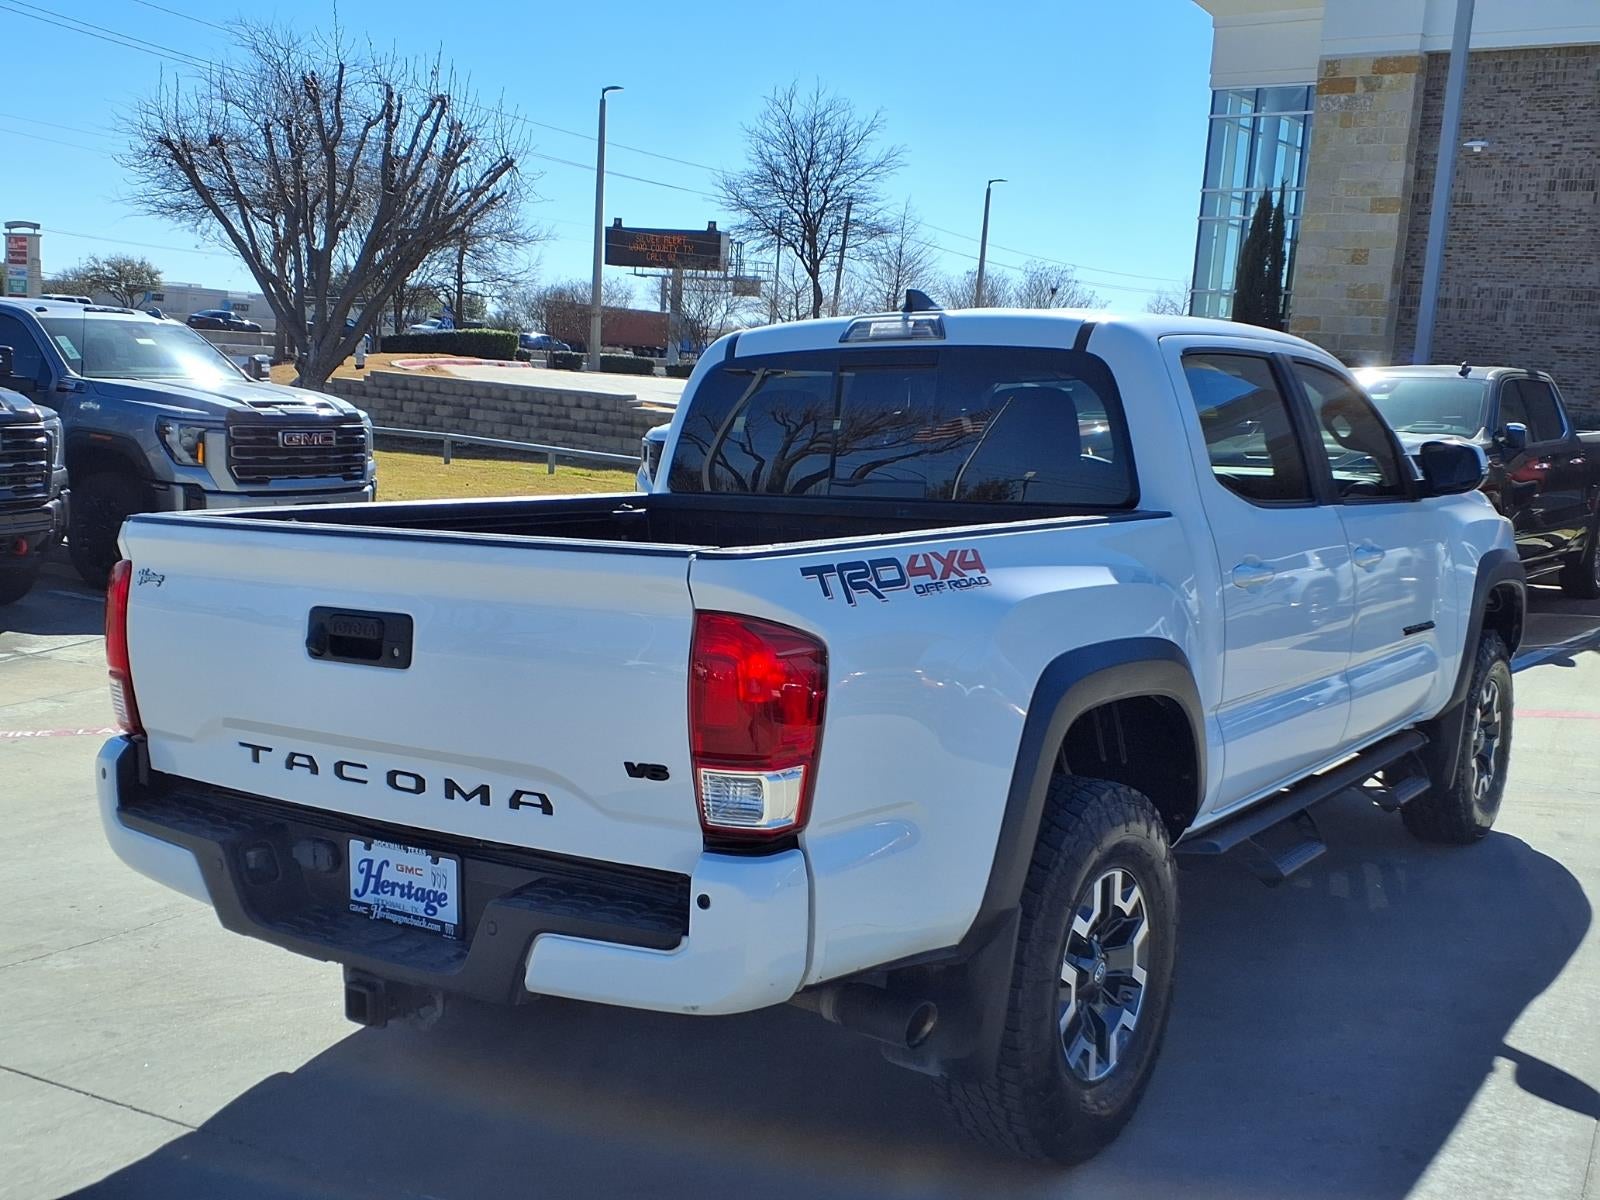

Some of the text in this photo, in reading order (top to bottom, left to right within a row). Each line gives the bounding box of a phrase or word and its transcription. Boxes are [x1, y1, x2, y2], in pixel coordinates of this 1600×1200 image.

[283, 432, 335, 446] GMC
[800, 548, 987, 607] TRD 4X4
[914, 576, 990, 597] OFF ROAD
[238, 741, 554, 816] TACOMA
[623, 761, 670, 781] V6
[395, 863, 424, 877] GMC
[353, 857, 449, 917] Heritage
[348, 903, 369, 914] GMC
